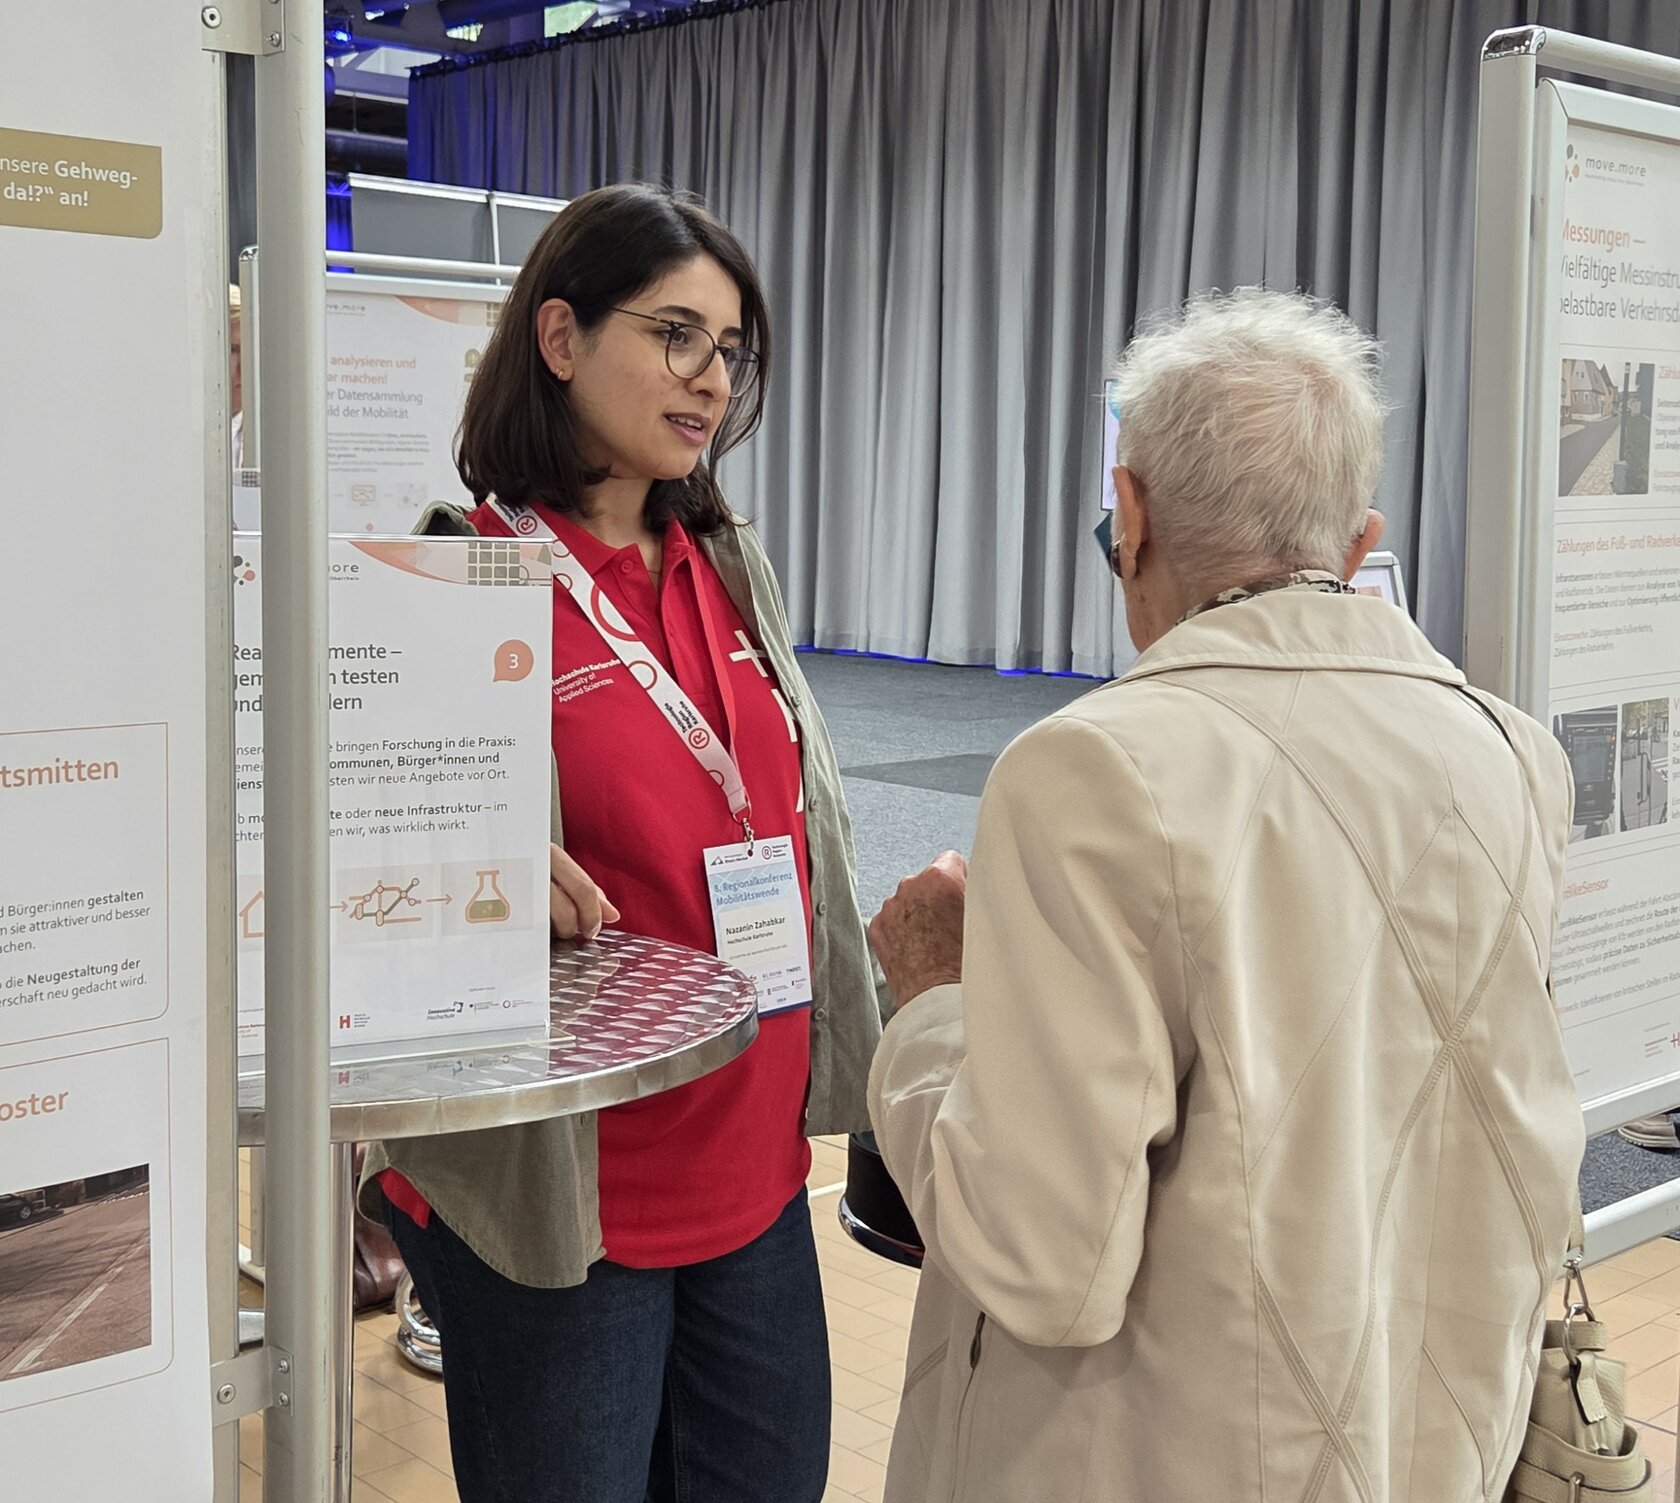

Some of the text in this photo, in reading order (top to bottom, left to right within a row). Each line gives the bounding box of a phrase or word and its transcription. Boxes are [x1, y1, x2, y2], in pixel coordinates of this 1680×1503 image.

[54, 160, 139, 188] Gehweg-
[59, 190, 88, 206] an!
[395, 356, 416, 369] und
[337, 388, 423, 406] Datensammlung
[342, 404, 360, 417] der
[362, 406, 408, 419] Mobilität
[328, 563, 359, 573] ore
[508, 654, 519, 668] 3
[341, 669, 399, 685] testen
[553, 672, 596, 695] University of
[559, 678, 614, 703] Applied Sciences
[329, 693, 362, 709] ern
[336, 741, 379, 754] bringen
[382, 738, 442, 752] Forschung
[445, 738, 456, 749] in
[458, 737, 476, 748] die
[478, 735, 516, 748] Praxis:
[478, 752, 500, 764] und
[0, 757, 119, 788] tsmitten
[237, 777, 264, 790] iens
[358, 774, 375, 785] wir
[379, 774, 406, 784] neue
[409, 770, 464, 785] Angebote
[467, 771, 485, 781] vor
[487, 769, 510, 780] Ort.
[345, 807, 373, 819] oder
[374, 806, 404, 818] neue
[407, 803, 482, 817] Infrastruktur
[494, 801, 508, 812] im
[346, 825, 366, 838] wir,
[369, 824, 390, 835] was
[393, 820, 435, 833] wirklich
[438, 819, 469, 831] wirkt.
[8, 890, 144, 918] Bürger:innen gestalten
[10, 922, 27, 935] sie
[29, 915, 90, 933] attraktiver
[91, 909, 113, 924] und
[115, 906, 152, 920] besser
[0, 940, 36, 954] chen.
[5, 958, 142, 989] die Neugestaltung der
[0, 973, 147, 1008] rschaft neu gedacht wird.
[0, 1090, 70, 1121] oster
